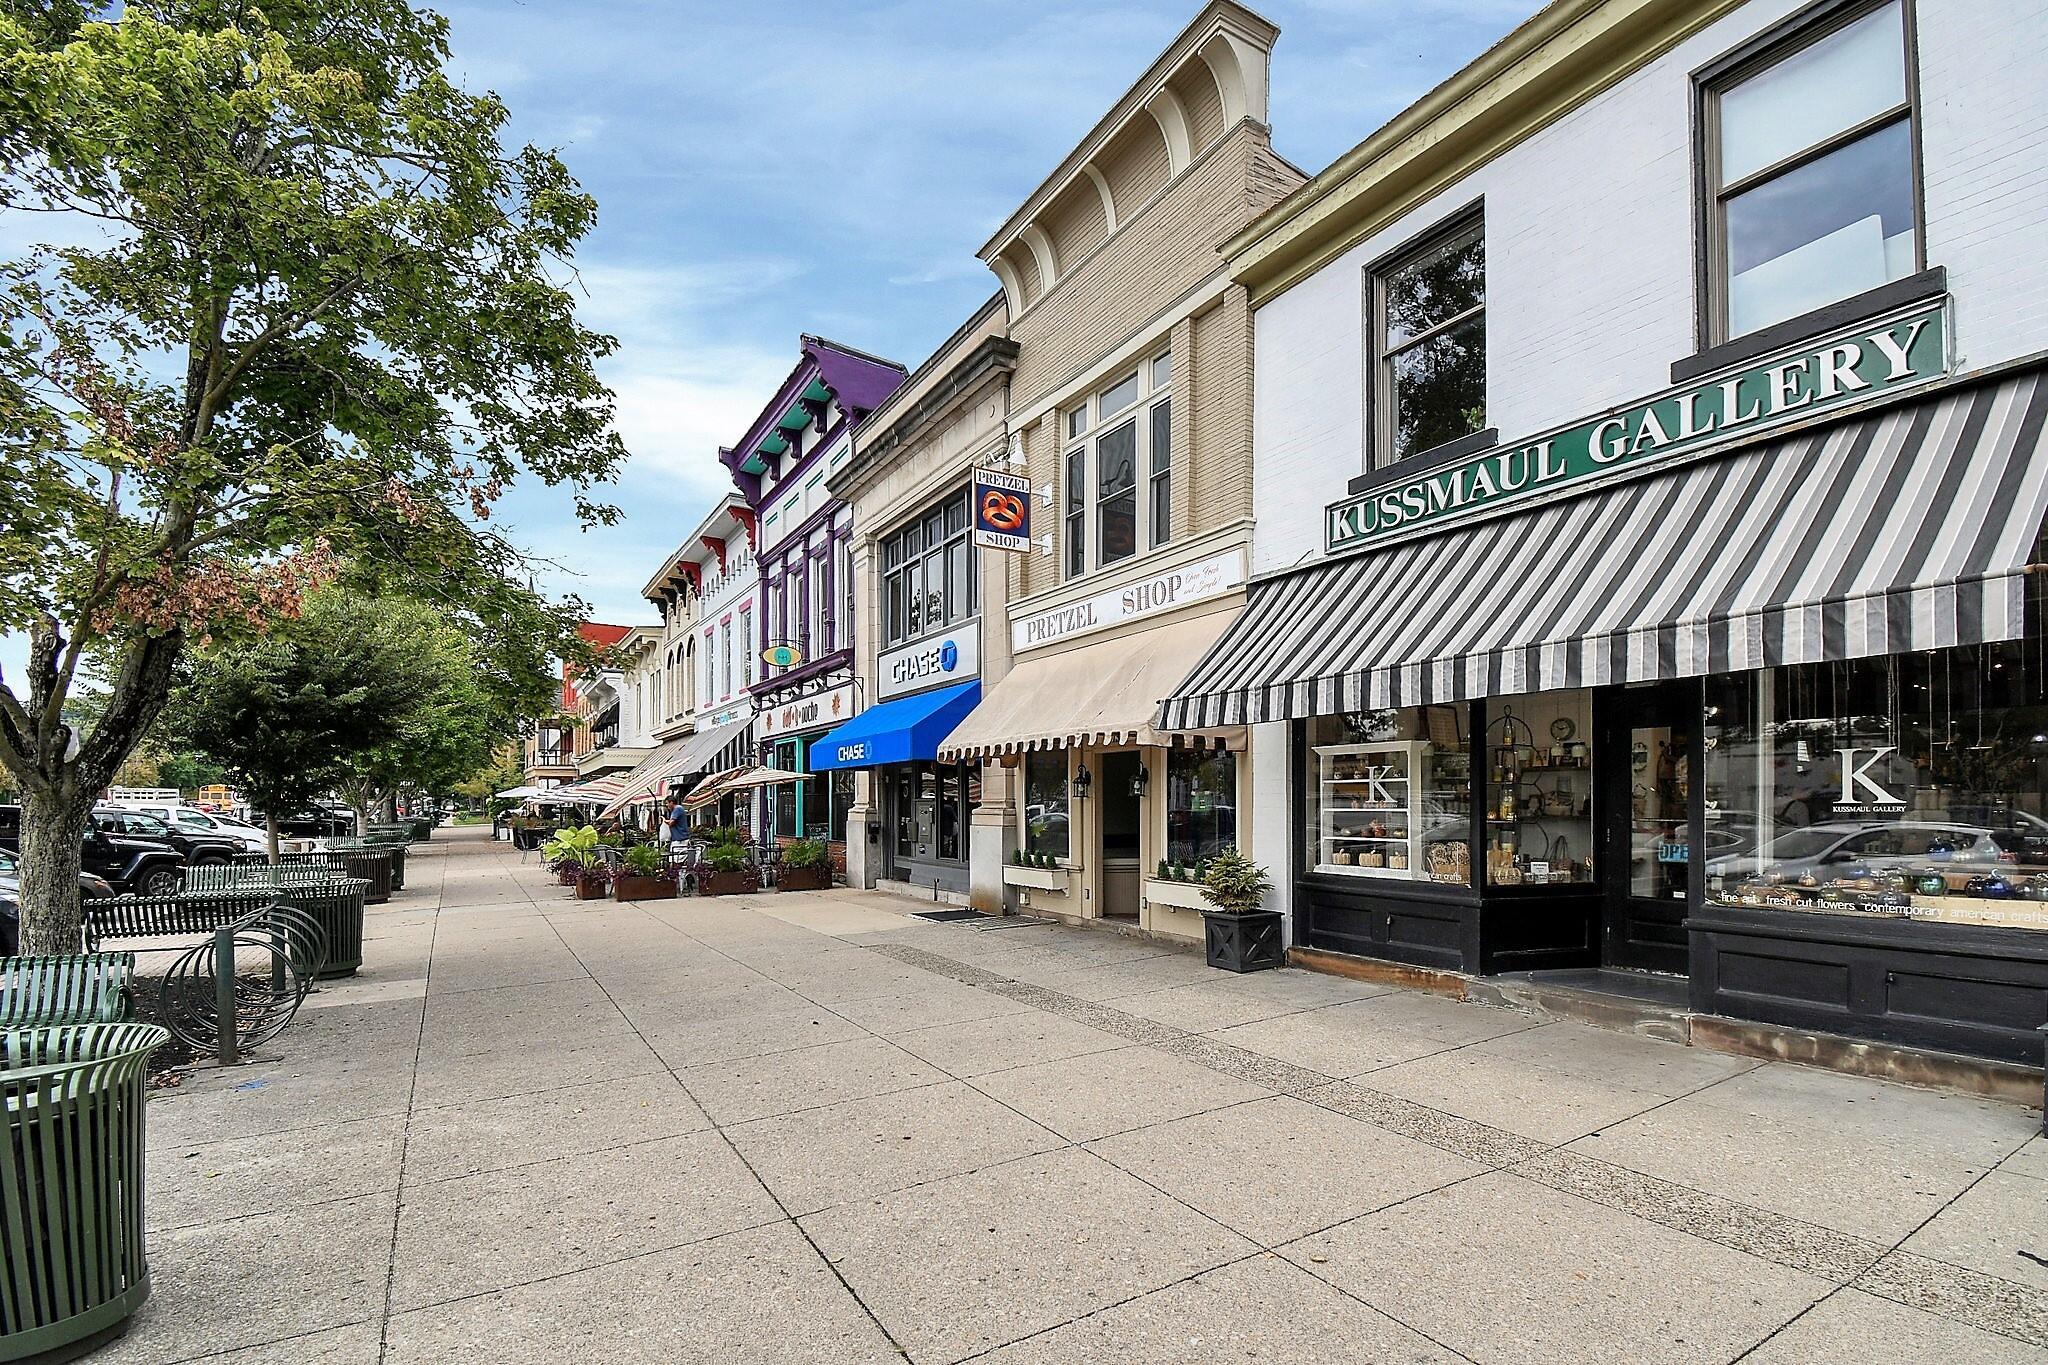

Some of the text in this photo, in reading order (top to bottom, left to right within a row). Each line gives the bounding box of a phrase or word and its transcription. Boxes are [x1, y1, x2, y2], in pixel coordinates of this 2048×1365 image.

[1331, 318, 1929, 542] KUSSMAUL GALLERY
[978, 471, 1028, 491] PRETZEL
[986, 533, 1020, 547] SHOP
[1027, 575, 1182, 643] PRETZEL SHOP
[892, 648, 940, 683] CHASE
[838, 743, 865, 761] CHASE
[1365, 765, 1398, 803] K
[1833, 746, 1907, 804] K
[1872, 805, 1906, 813] GALLERY
[1660, 845, 1689, 859] OPE
[1720, 890, 1738, 903] fine
[1766, 894, 1792, 906] fresh
[1796, 898, 1813, 908] cut
[1817, 898, 1856, 911] flowers
[1864, 902, 1944, 918] contemporary
[1951, 910, 2005, 920] american
[2011, 911, 2048, 923] crafts
